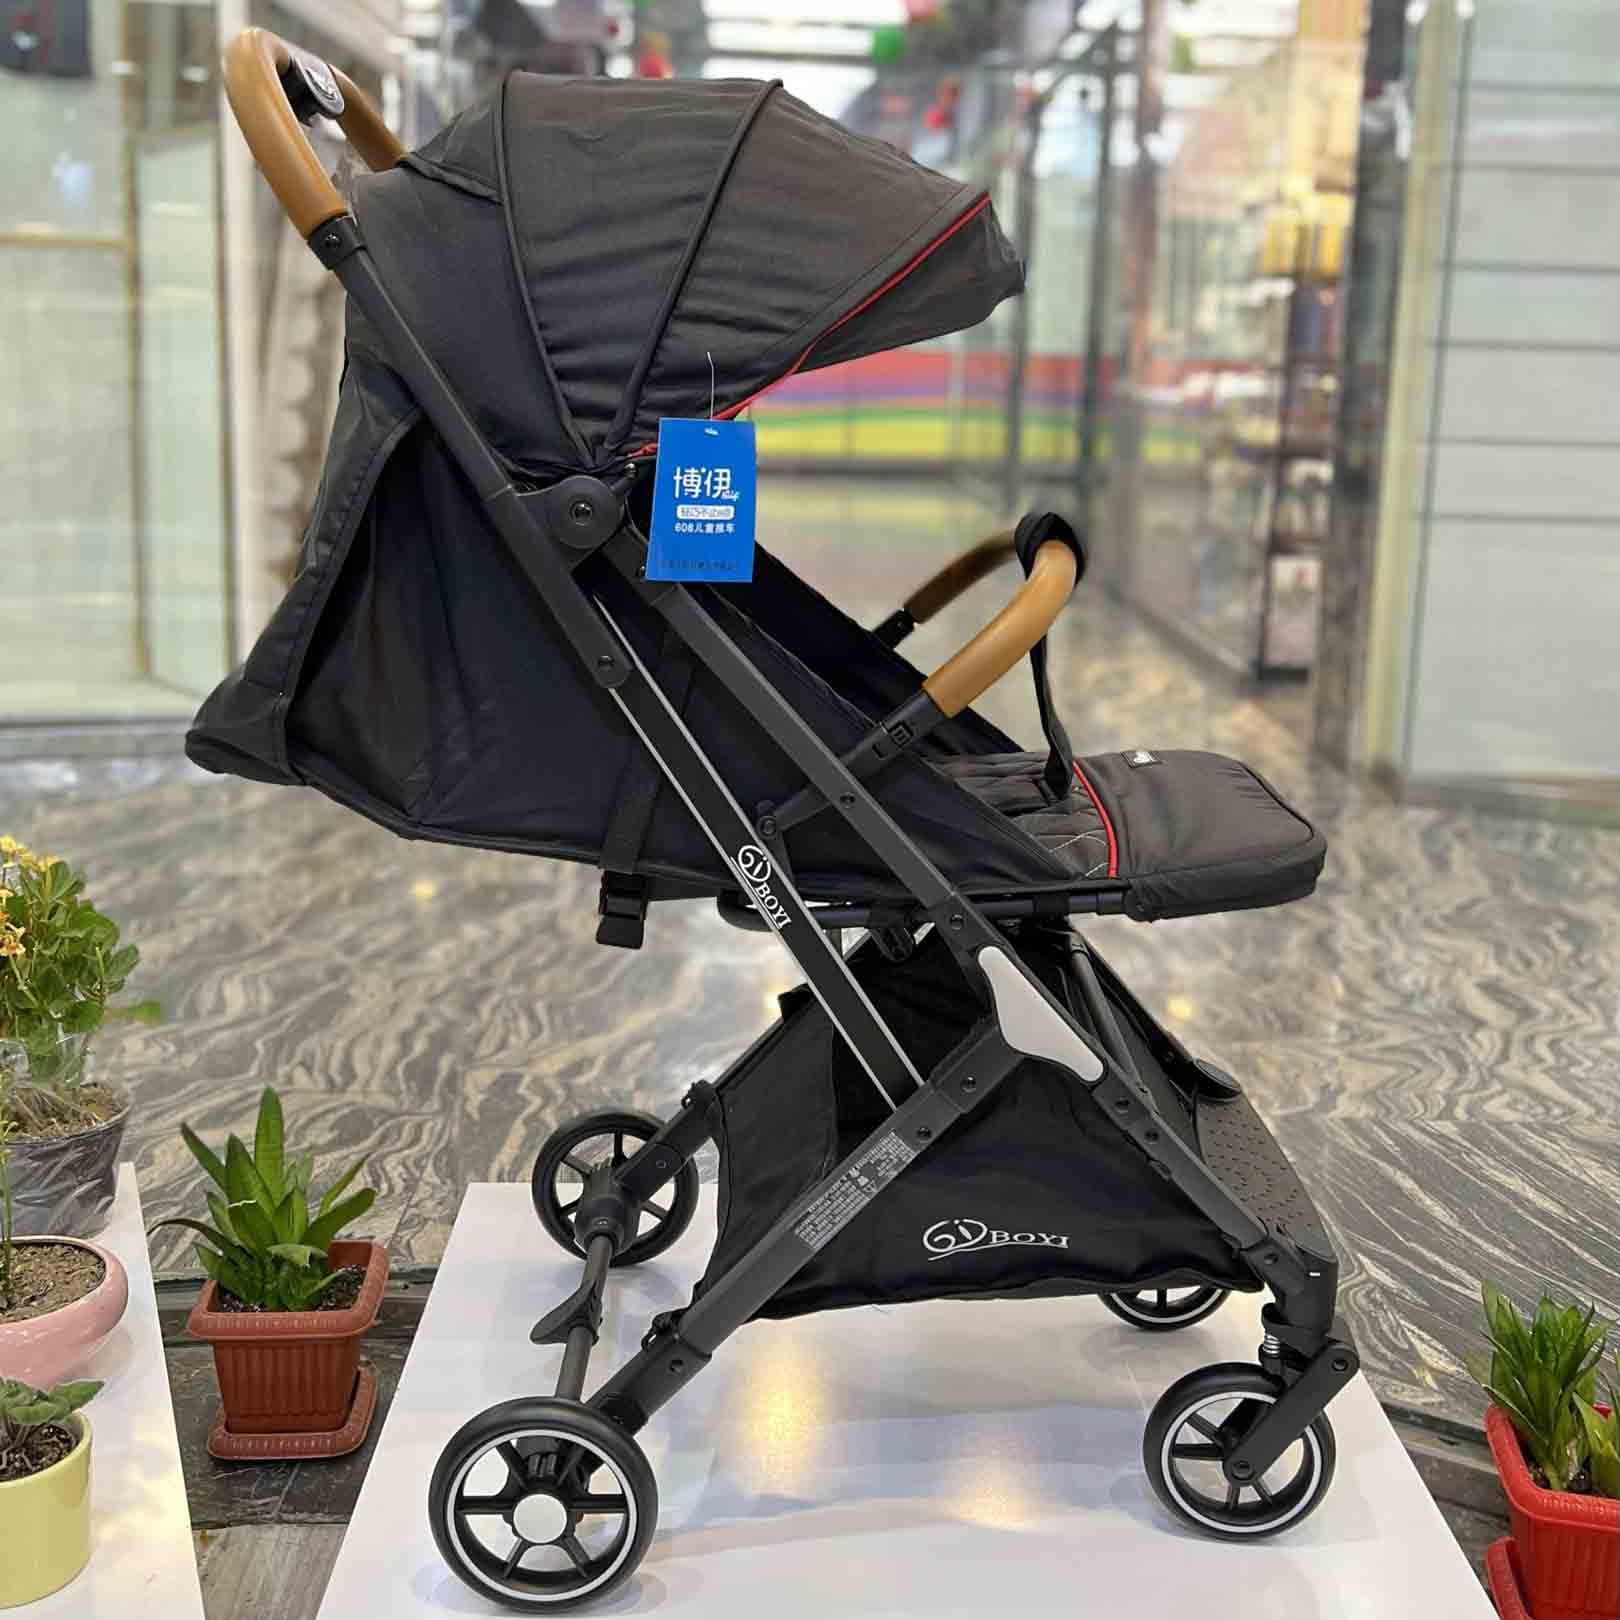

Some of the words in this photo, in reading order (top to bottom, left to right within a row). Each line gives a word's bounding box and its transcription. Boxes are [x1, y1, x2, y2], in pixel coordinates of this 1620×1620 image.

[673, 467, 731, 498] 博伊
[754, 882, 792, 929] BOYI
[989, 1230, 1071, 1249] BOYI
